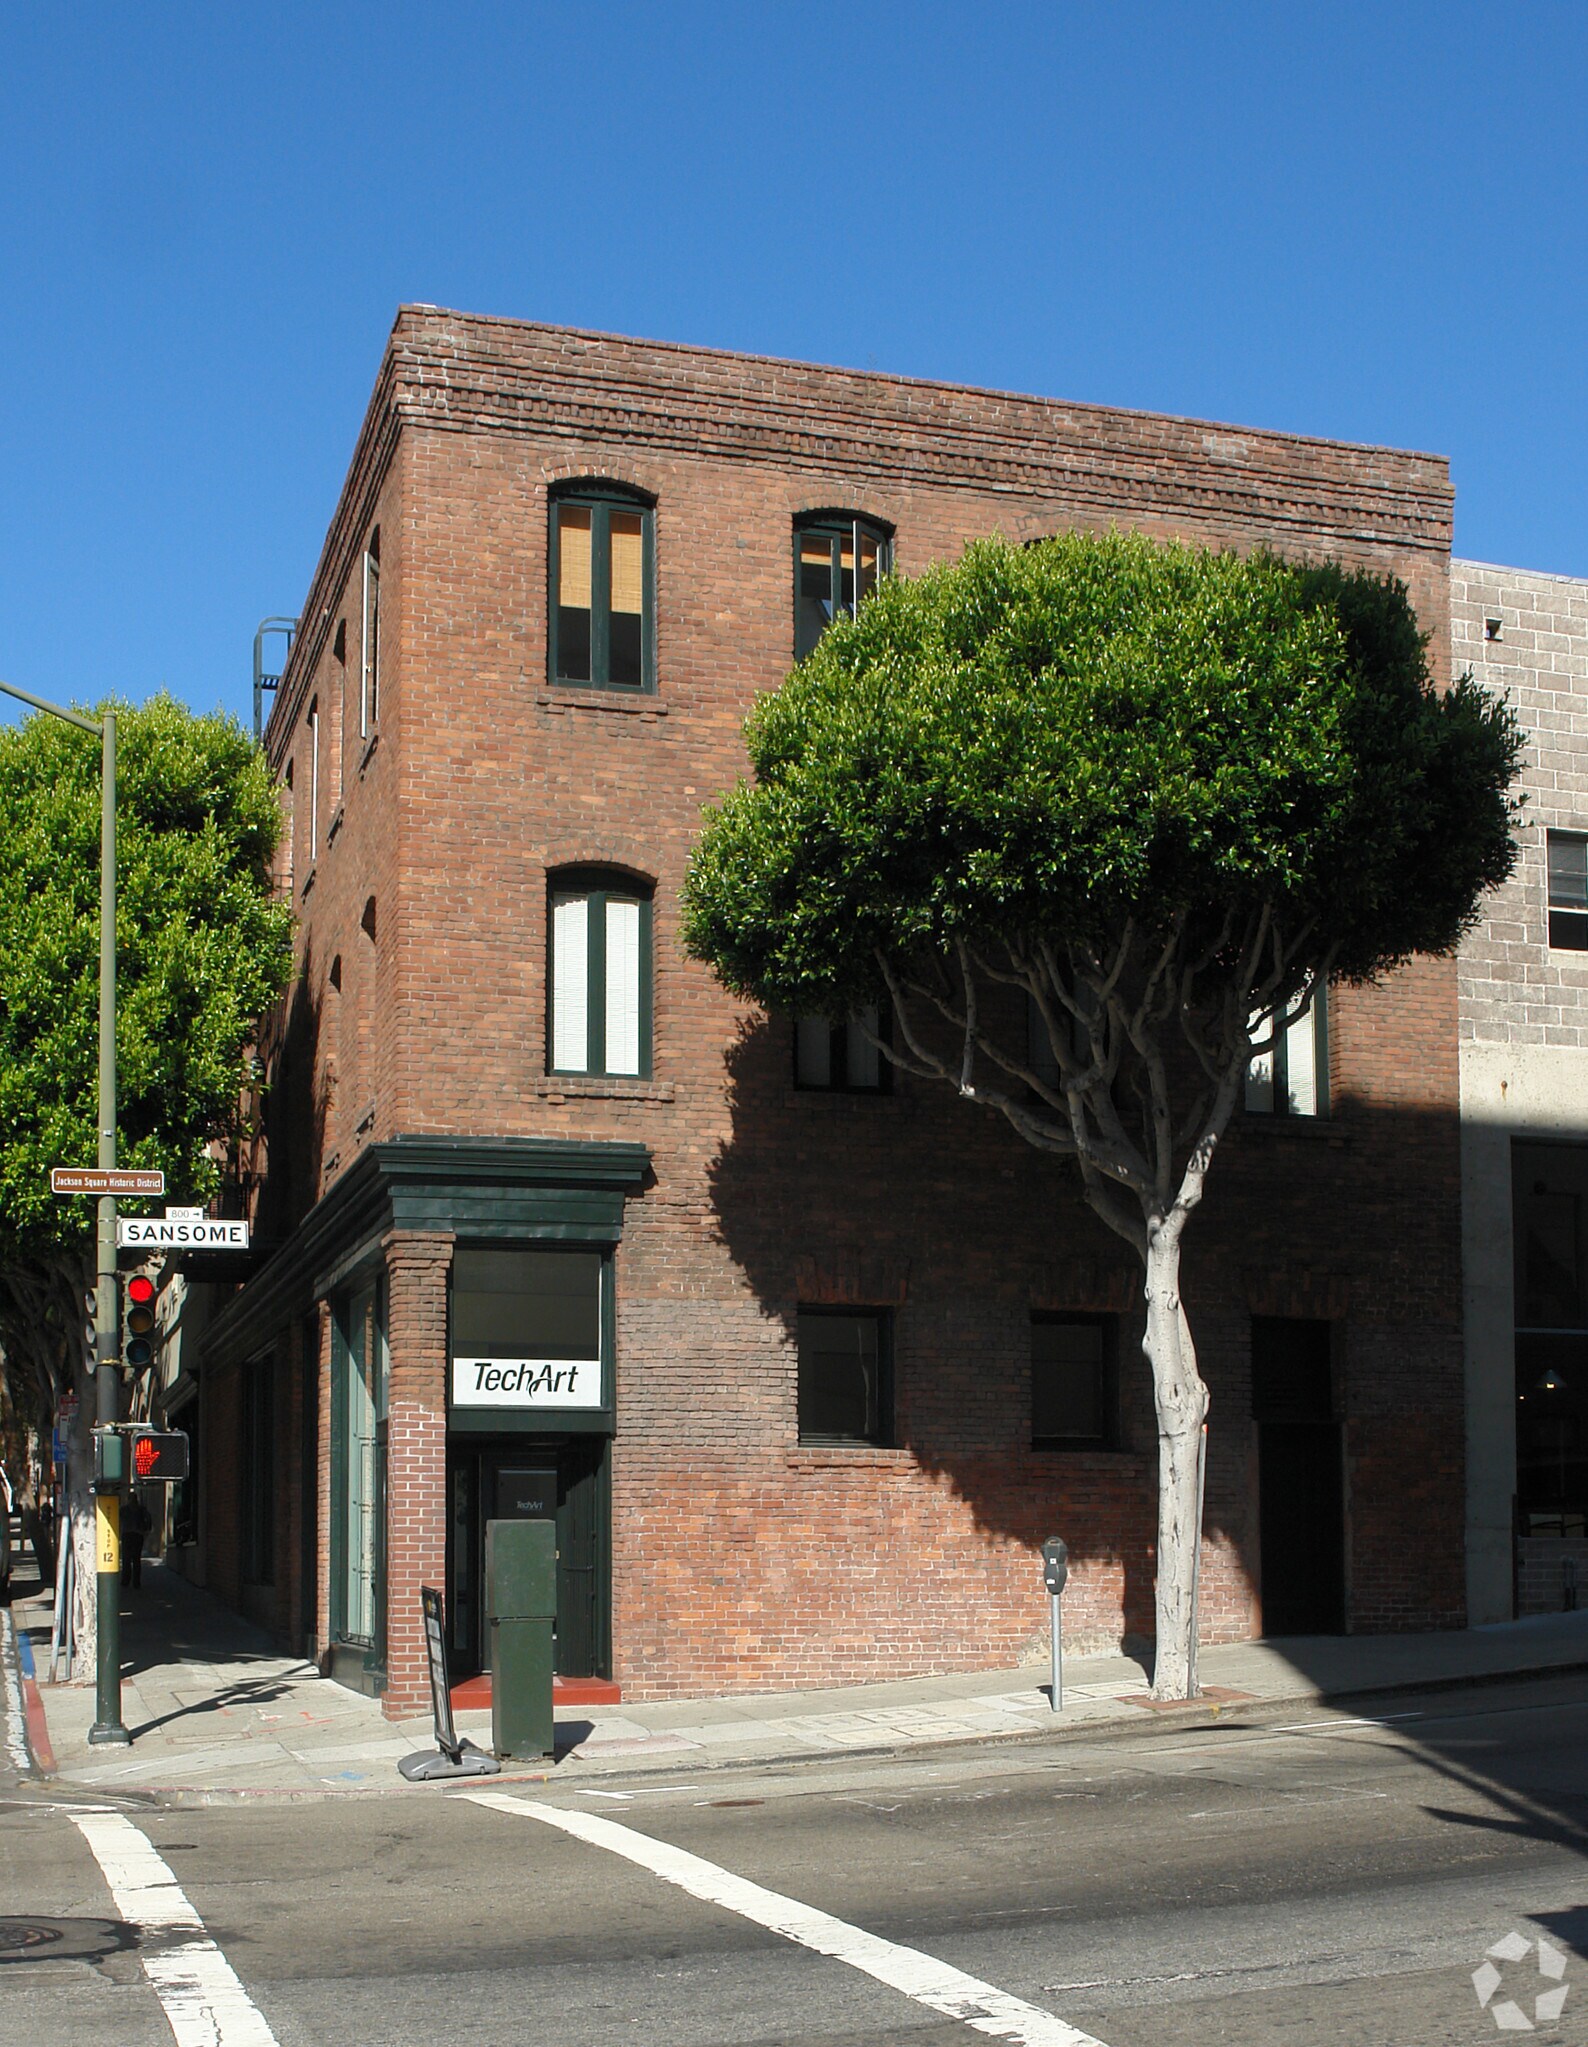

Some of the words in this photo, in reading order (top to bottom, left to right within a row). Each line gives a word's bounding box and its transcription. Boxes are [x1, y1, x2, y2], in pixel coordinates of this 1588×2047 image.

[56, 1176, 82, 1186] Jackson
[84, 1176, 107, 1188] Square
[109, 1177, 135, 1187] Historic
[136, 1178, 161, 1188] District
[171, 1209, 190, 1218] 800
[128, 1225, 242, 1242] SANSOME
[474, 1362, 579, 1400] TechArt
[103, 1552, 114, 1563] 12
